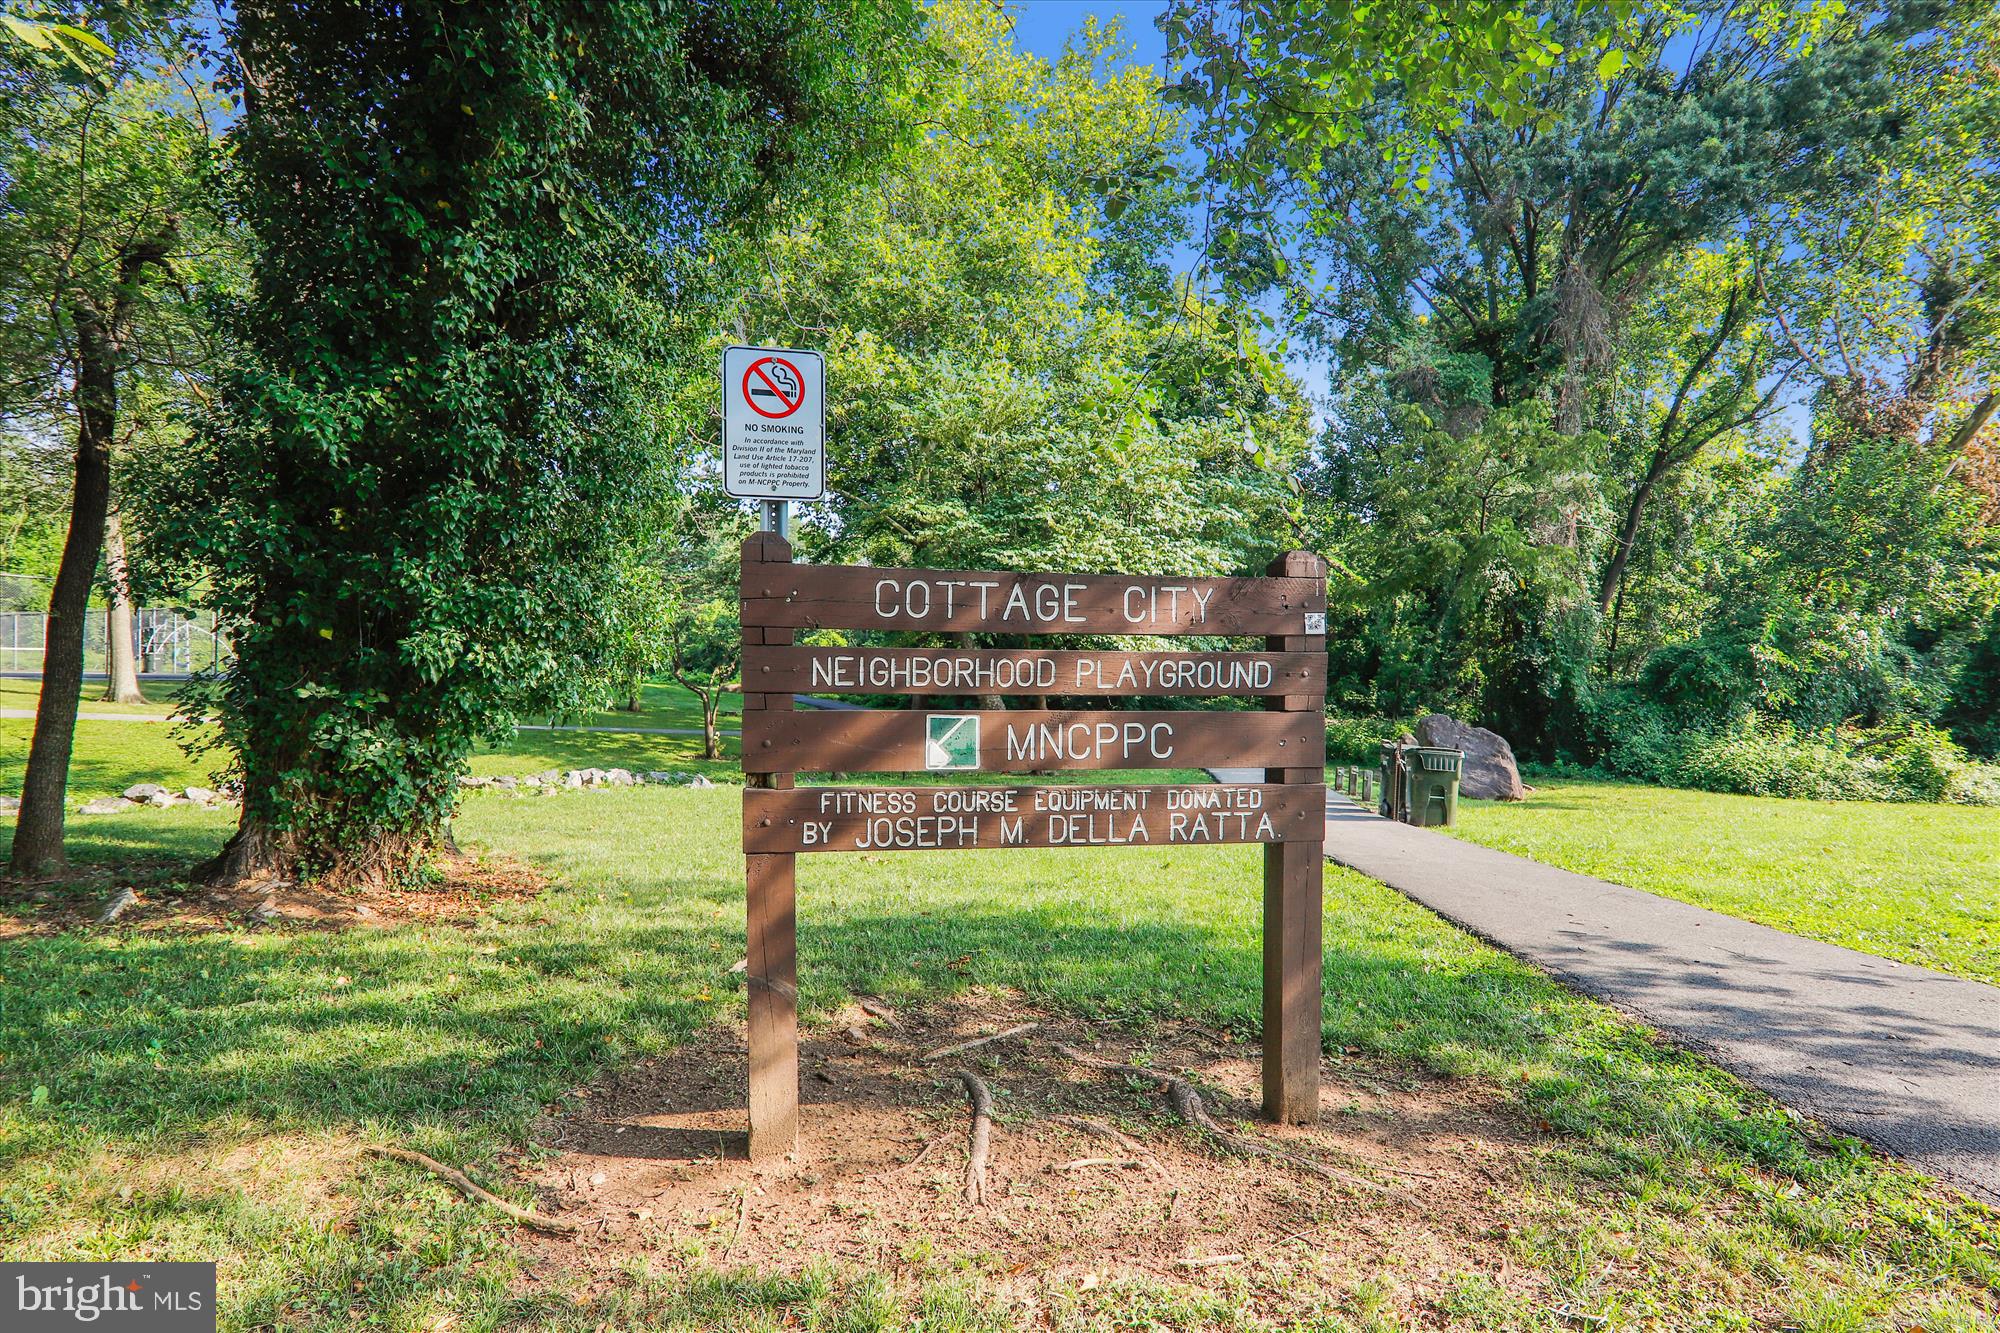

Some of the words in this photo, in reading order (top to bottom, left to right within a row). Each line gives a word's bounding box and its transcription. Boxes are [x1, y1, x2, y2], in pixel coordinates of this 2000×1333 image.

[745, 424, 758, 432] NO
[761, 424, 804, 434] SMOKING
[732, 444, 757, 452] Division
[761, 462, 783, 470] lighted
[765, 454, 786, 462] Article
[788, 455, 815, 464] 17-207,
[748, 478, 780, 486] M-NCPPC
[782, 480, 810, 488] Property.
[875, 579, 1088, 623] COTTAGE
[1122, 585, 1214, 624] CITY
[811, 656, 1056, 689] NEIGHBORHOOD
[1076, 658, 1273, 689] PLAYGROUND
[1007, 722, 1175, 761] MNCPPC
[820, 790, 917, 814] FITNESS
[933, 790, 1019, 813] COURSE
[1034, 789, 1152, 812] EQUIPMENT
[1167, 788, 1263, 810] DONATED
[802, 820, 832, 845] BY
[855, 816, 978, 848] JOSEPH
[1000, 815, 1029, 845] M.
[1049, 813, 1151, 844] DELLA
[1169, 811, 1283, 842] RATTA.
